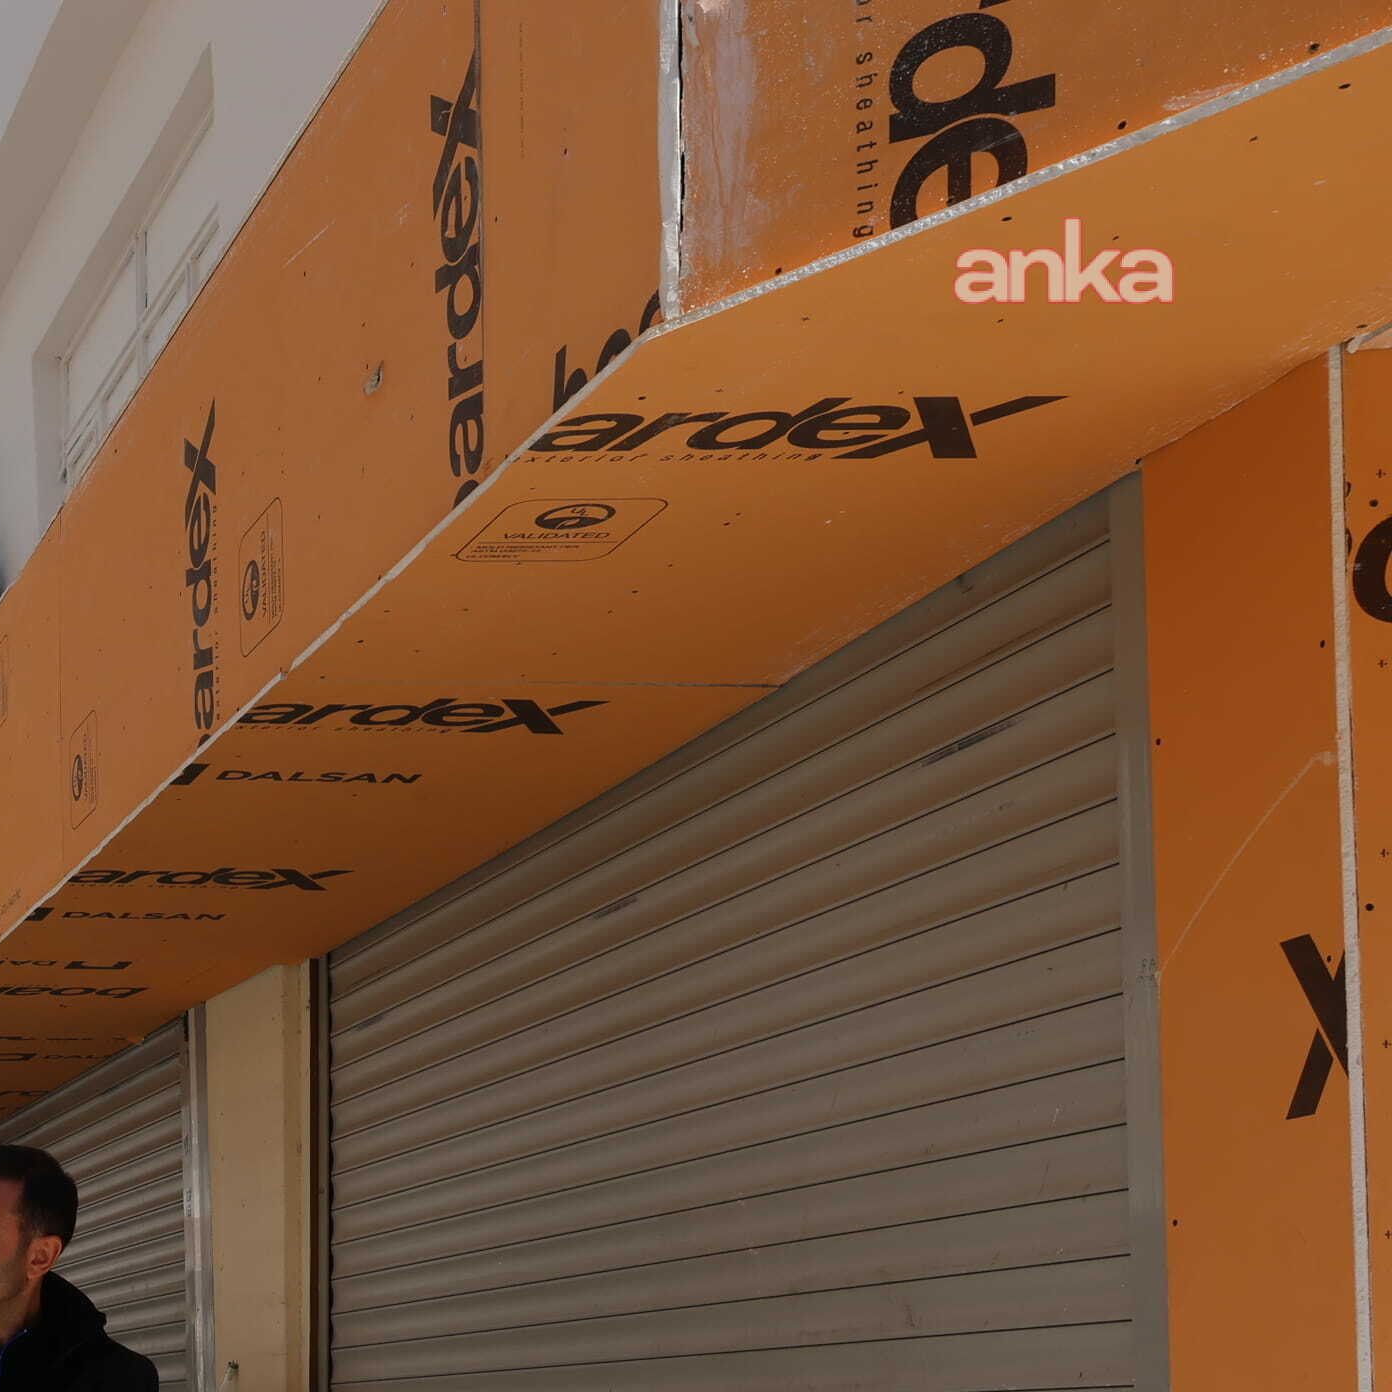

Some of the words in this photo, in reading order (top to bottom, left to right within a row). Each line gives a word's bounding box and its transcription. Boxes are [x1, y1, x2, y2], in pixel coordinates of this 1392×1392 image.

[852, 50, 878, 239] sheathing
[215, 770, 423, 785] DALSAN
[61, 911, 226, 921] DALSAN
